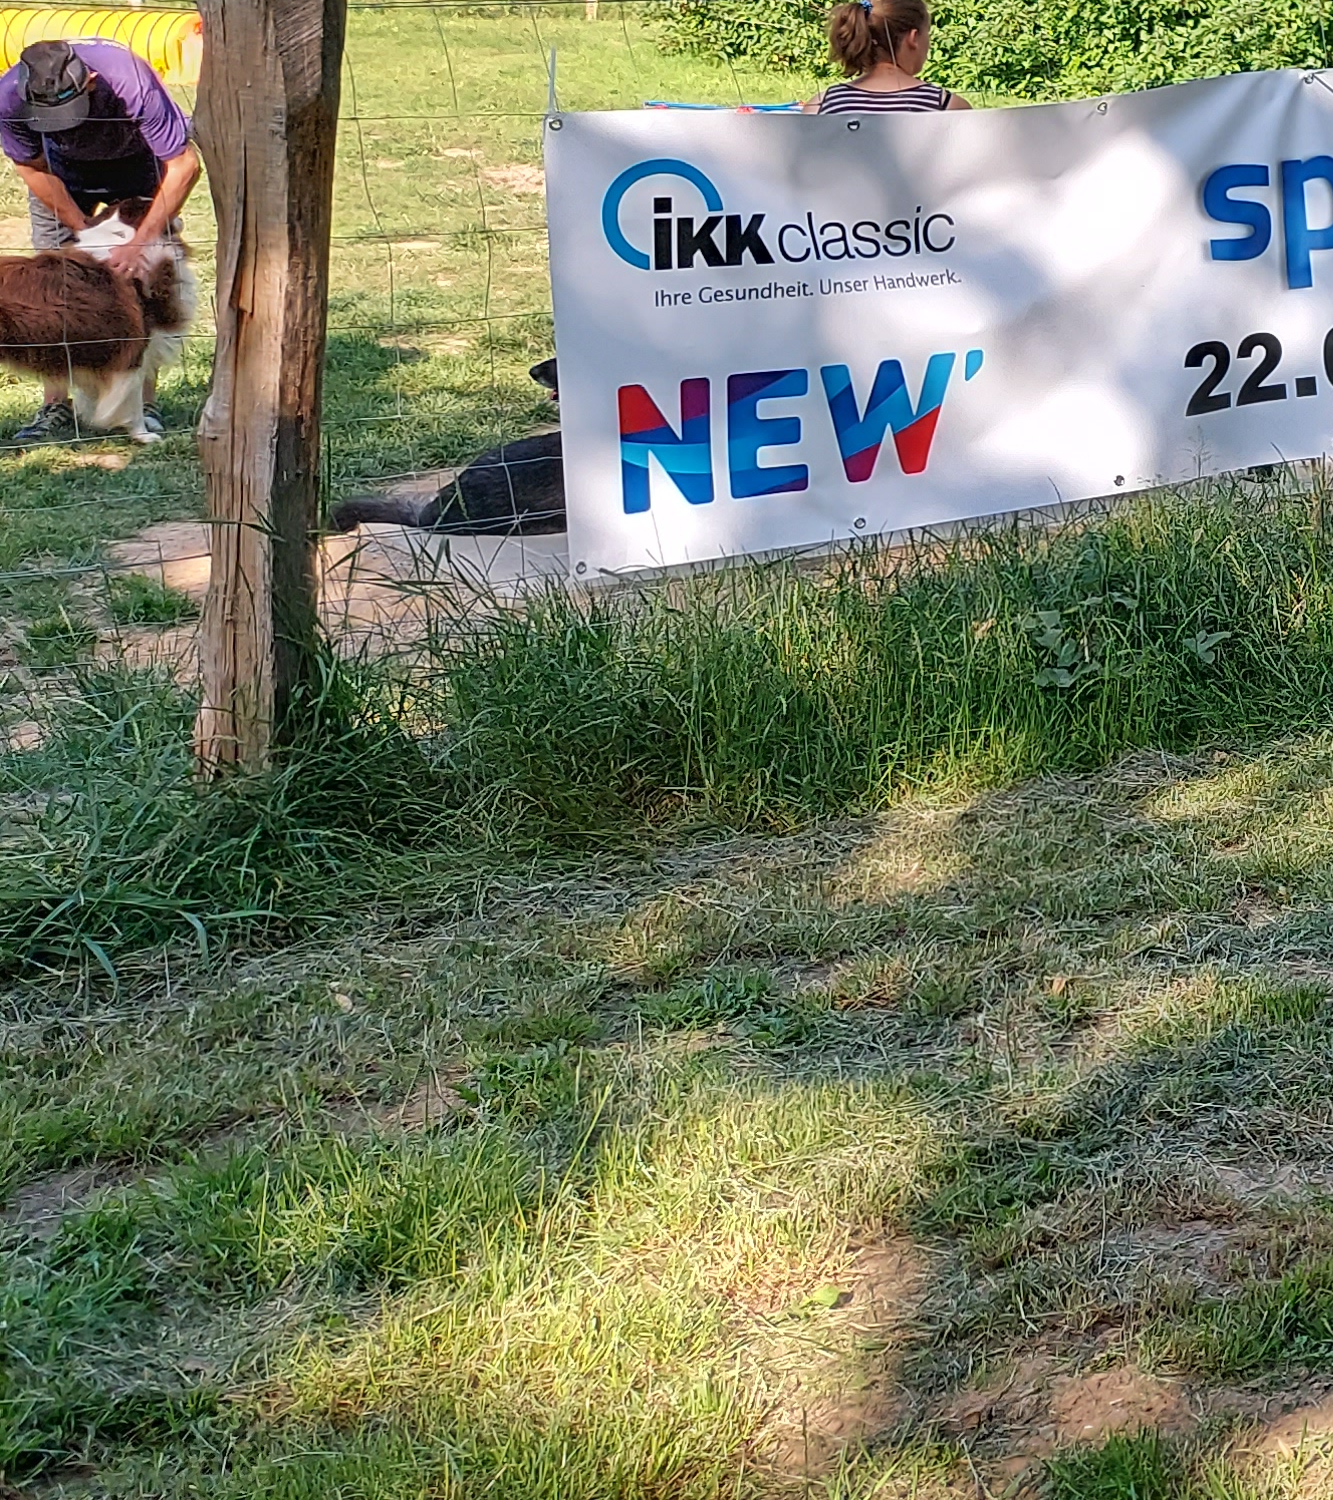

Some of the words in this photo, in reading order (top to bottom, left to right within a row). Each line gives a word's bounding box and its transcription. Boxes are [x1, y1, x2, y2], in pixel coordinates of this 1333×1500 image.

[777, 205, 956, 263] classic
[654, 289, 692, 308] Ihre
[698, 280, 815, 304] Gesundheit.
[819, 277, 870, 296] Unser
[873, 268, 963, 293] Handwerk.
